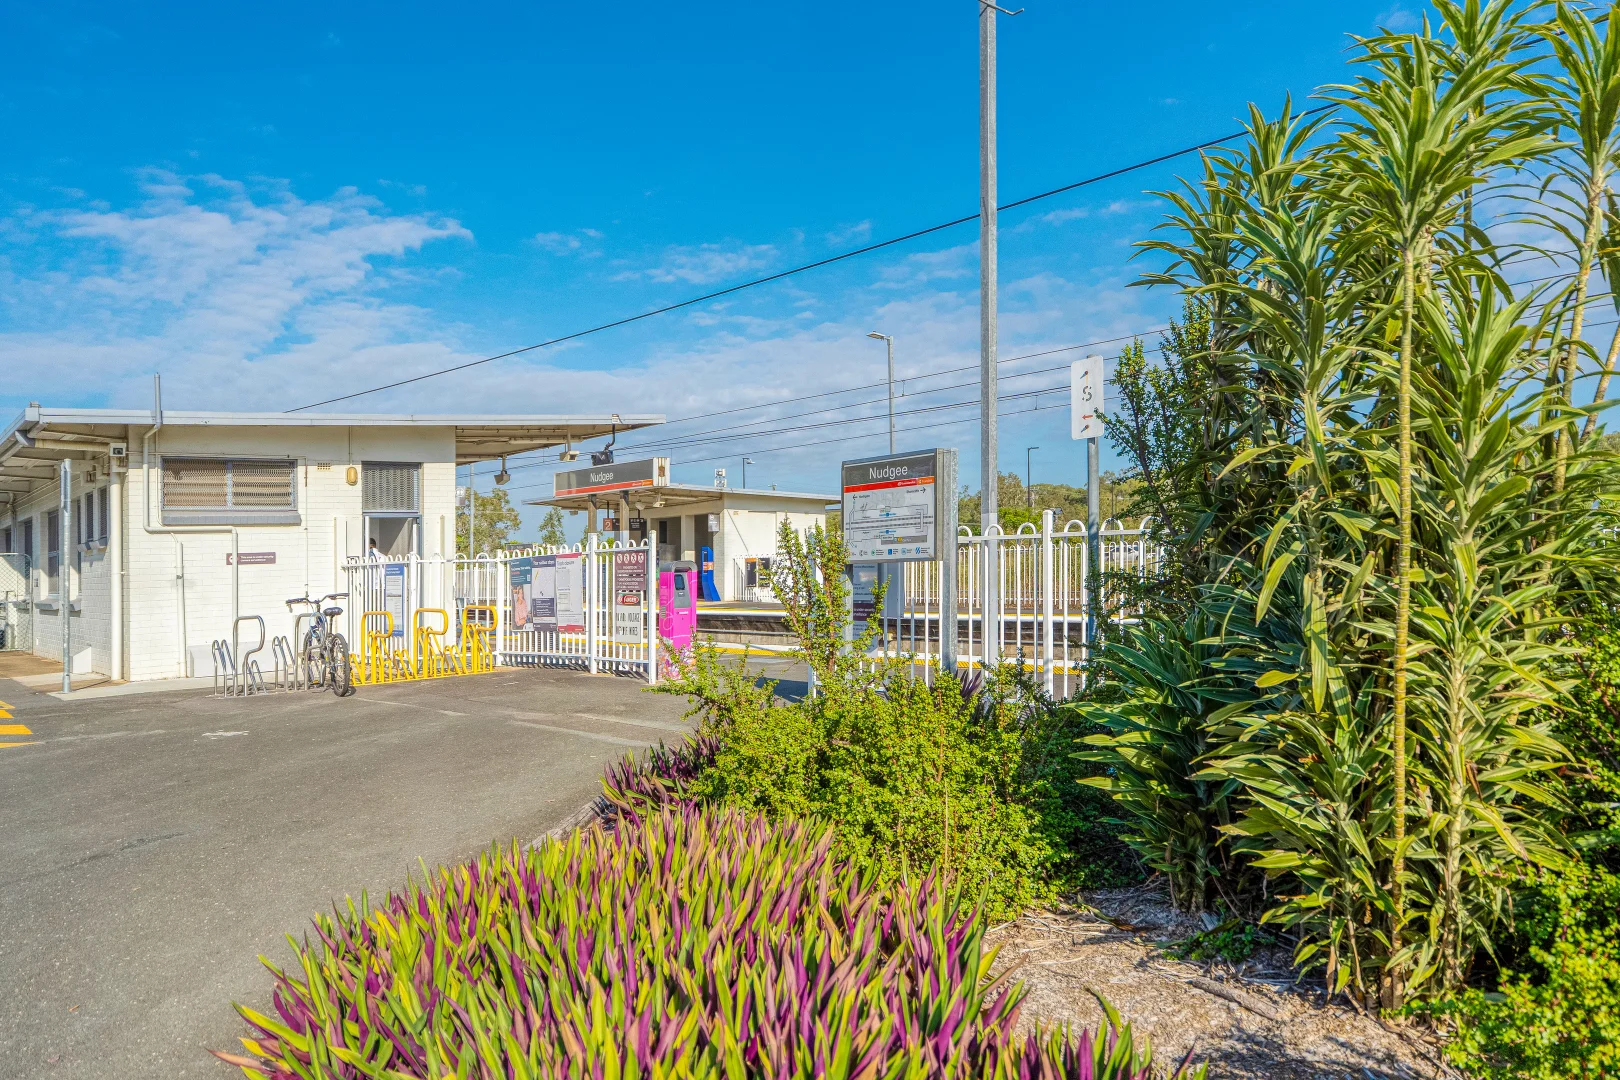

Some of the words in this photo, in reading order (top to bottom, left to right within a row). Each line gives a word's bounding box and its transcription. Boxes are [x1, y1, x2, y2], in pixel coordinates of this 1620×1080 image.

[590, 471, 613, 483] Nudgee
[869, 465, 908, 479] Nudgee
[605, 521, 611, 530] 2
